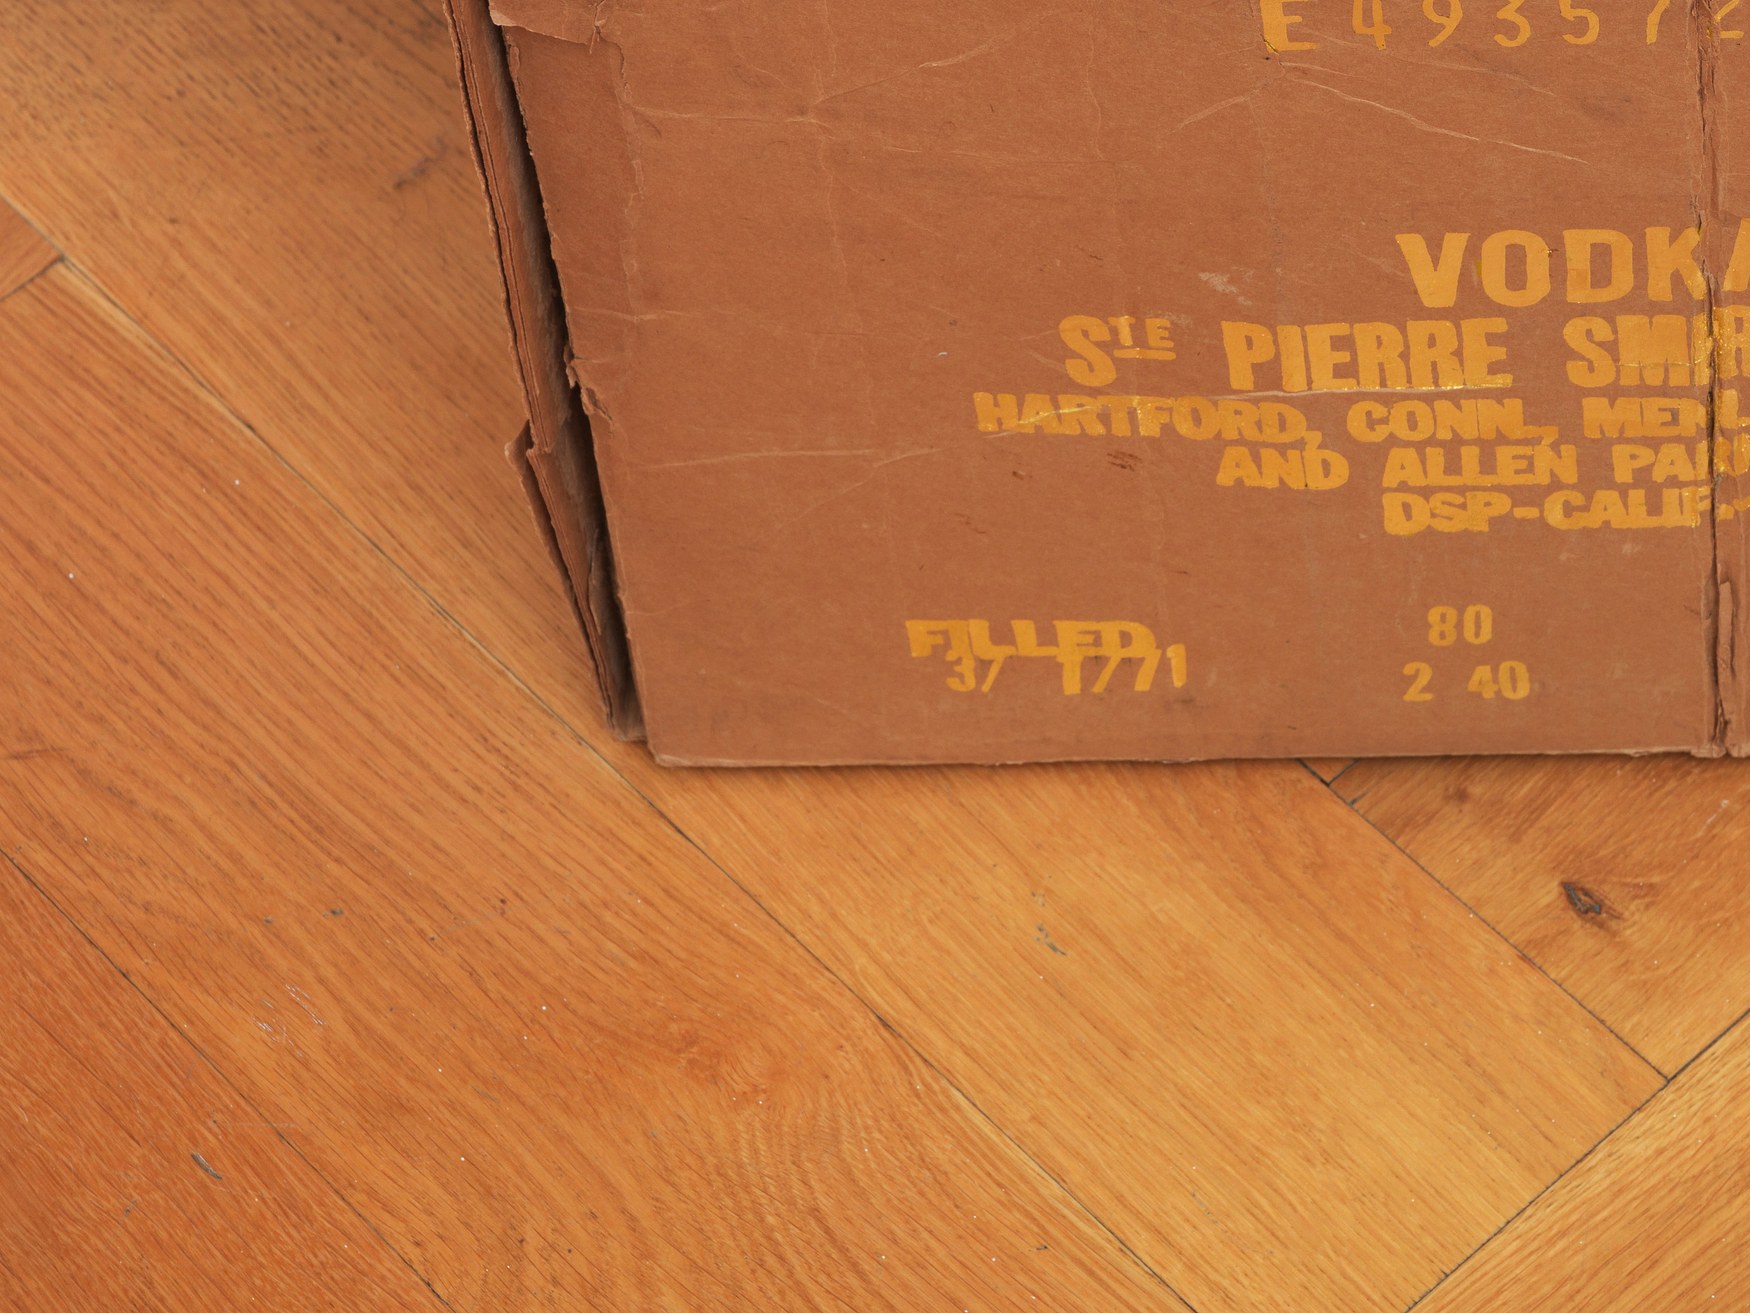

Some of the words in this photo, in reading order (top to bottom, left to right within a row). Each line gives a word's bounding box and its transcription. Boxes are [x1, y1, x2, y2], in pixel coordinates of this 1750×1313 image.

[1220, 317, 1514, 392] PIERRE
[974, 392, 1325, 450] HARTFORD,
[1216, 446, 1349, 490] AND
[1382, 445, 1578, 487] ALLEN
[1427, 604, 1493, 646] 80
